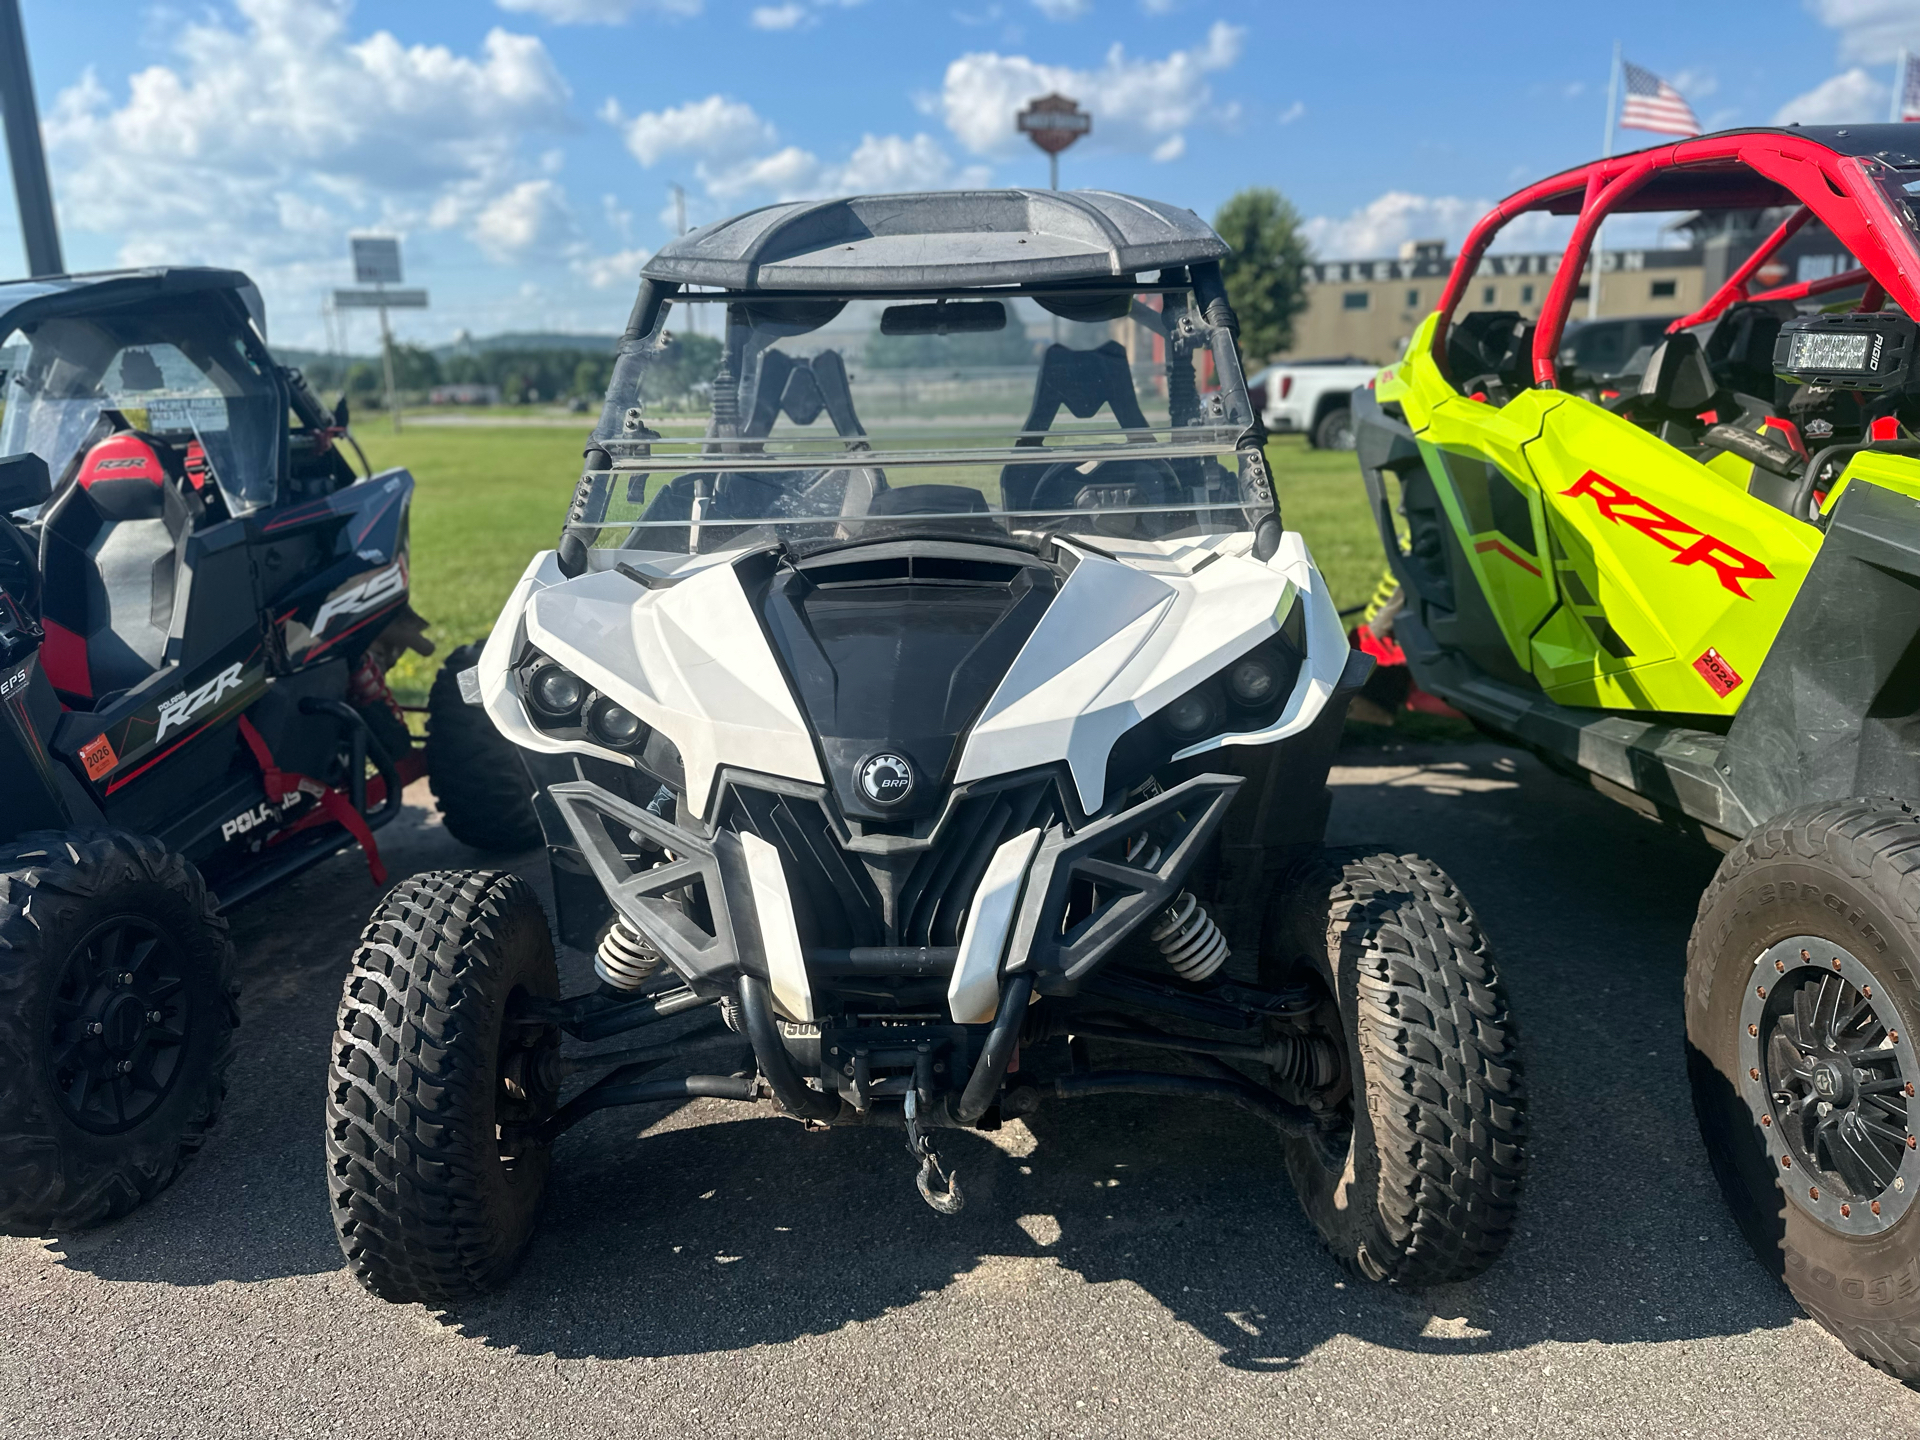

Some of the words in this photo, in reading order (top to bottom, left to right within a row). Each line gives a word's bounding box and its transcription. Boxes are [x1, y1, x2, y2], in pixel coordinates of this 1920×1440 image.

[1869, 333, 1884, 371] RIGID
[94, 457, 149, 473] RZR
[1557, 469, 1776, 602] RZR
[0, 669, 26, 695] EPS
[1702, 654, 1734, 688] 2024
[155, 661, 243, 744] RZR
[157, 690, 187, 713] POLARIS
[86, 745, 110, 769] 2026
[881, 779, 909, 788] BRP
[221, 790, 301, 842] POLAIS
